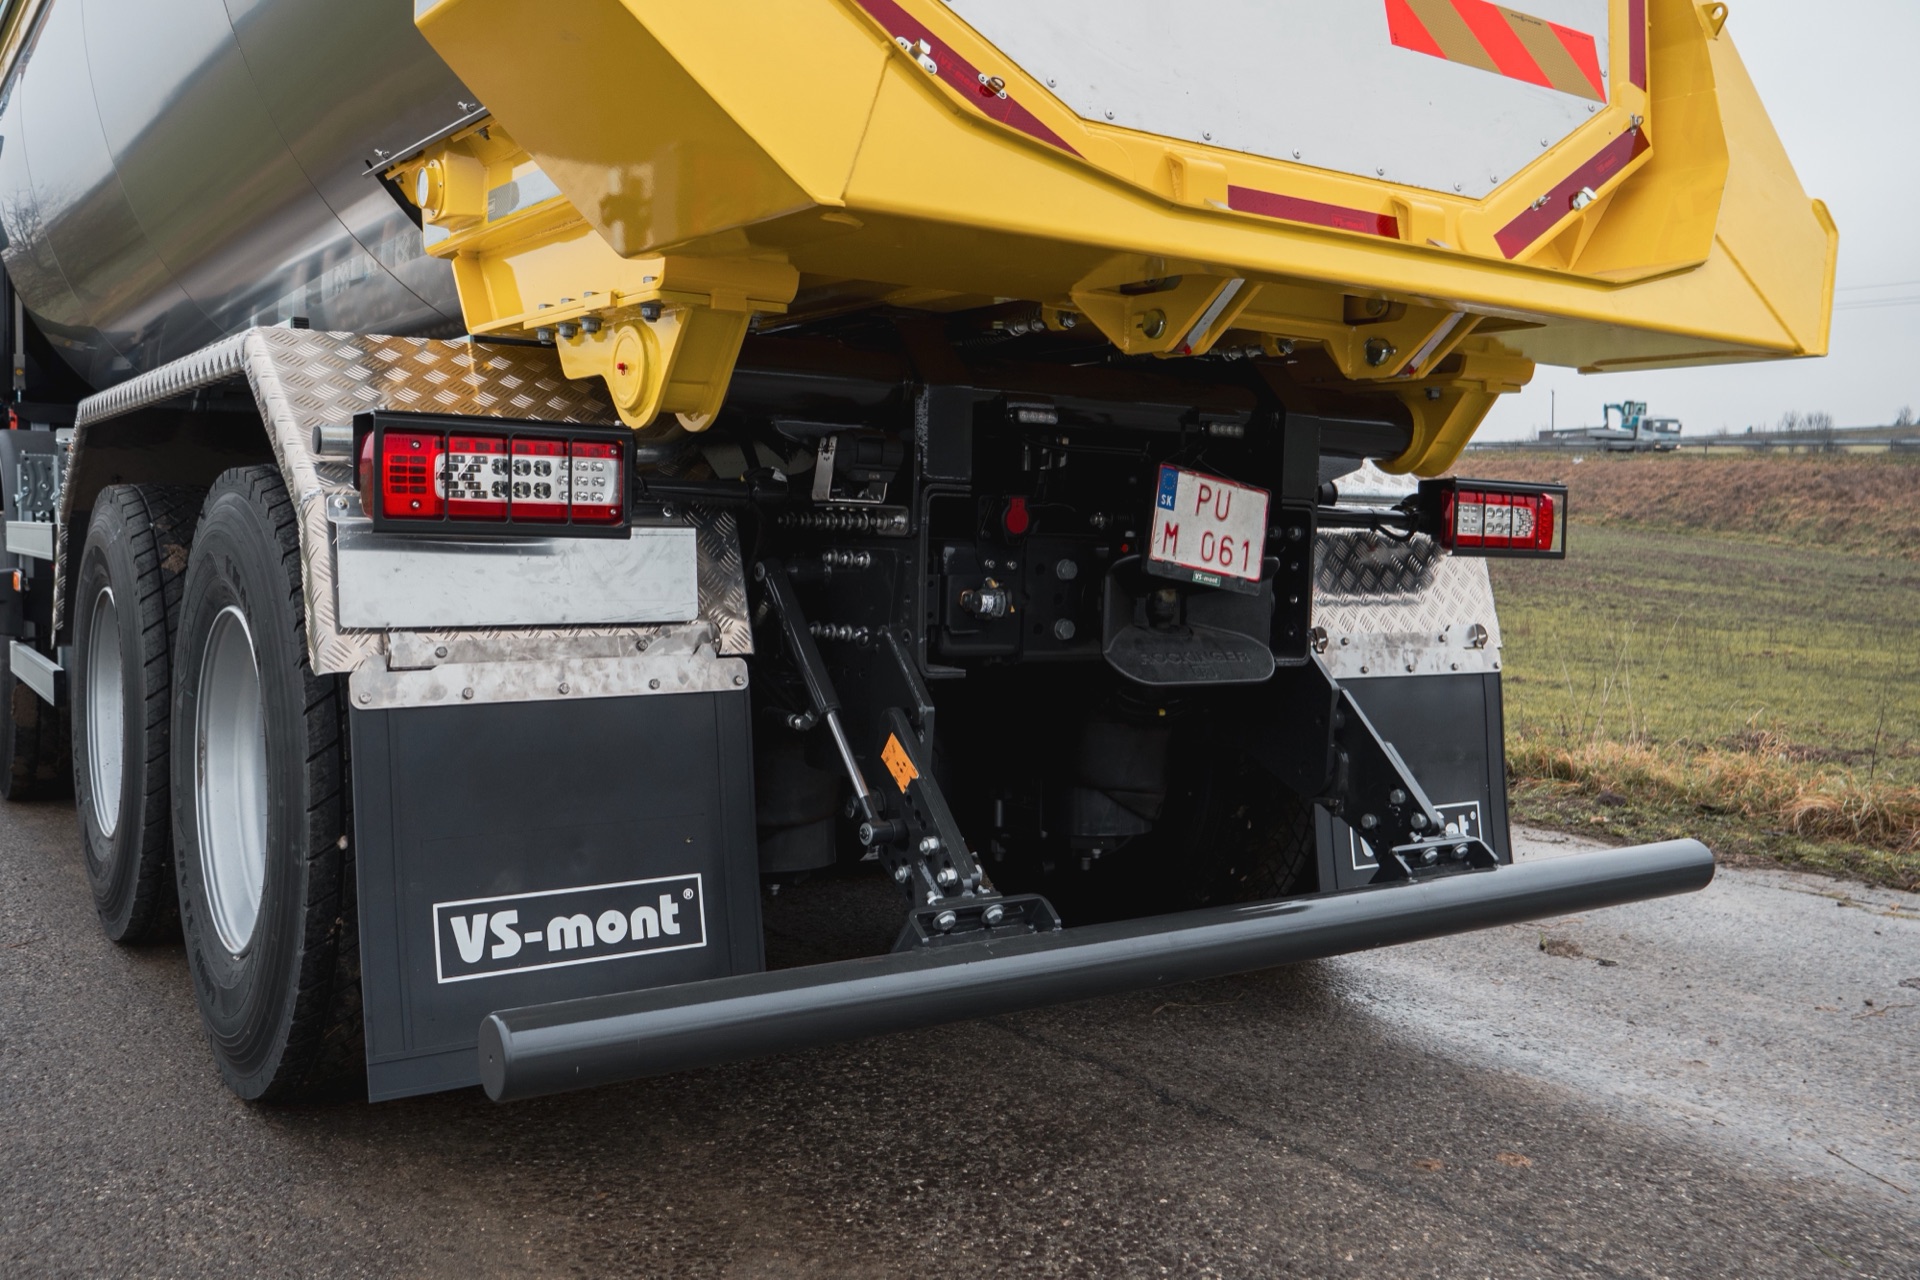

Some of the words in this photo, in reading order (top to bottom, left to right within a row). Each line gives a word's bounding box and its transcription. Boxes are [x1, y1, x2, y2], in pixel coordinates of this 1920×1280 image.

[1160, 494, 1173, 507] SK
[1194, 482, 1232, 522] PU
[1162, 520, 1180, 557] M
[1200, 530, 1251, 572] 061
